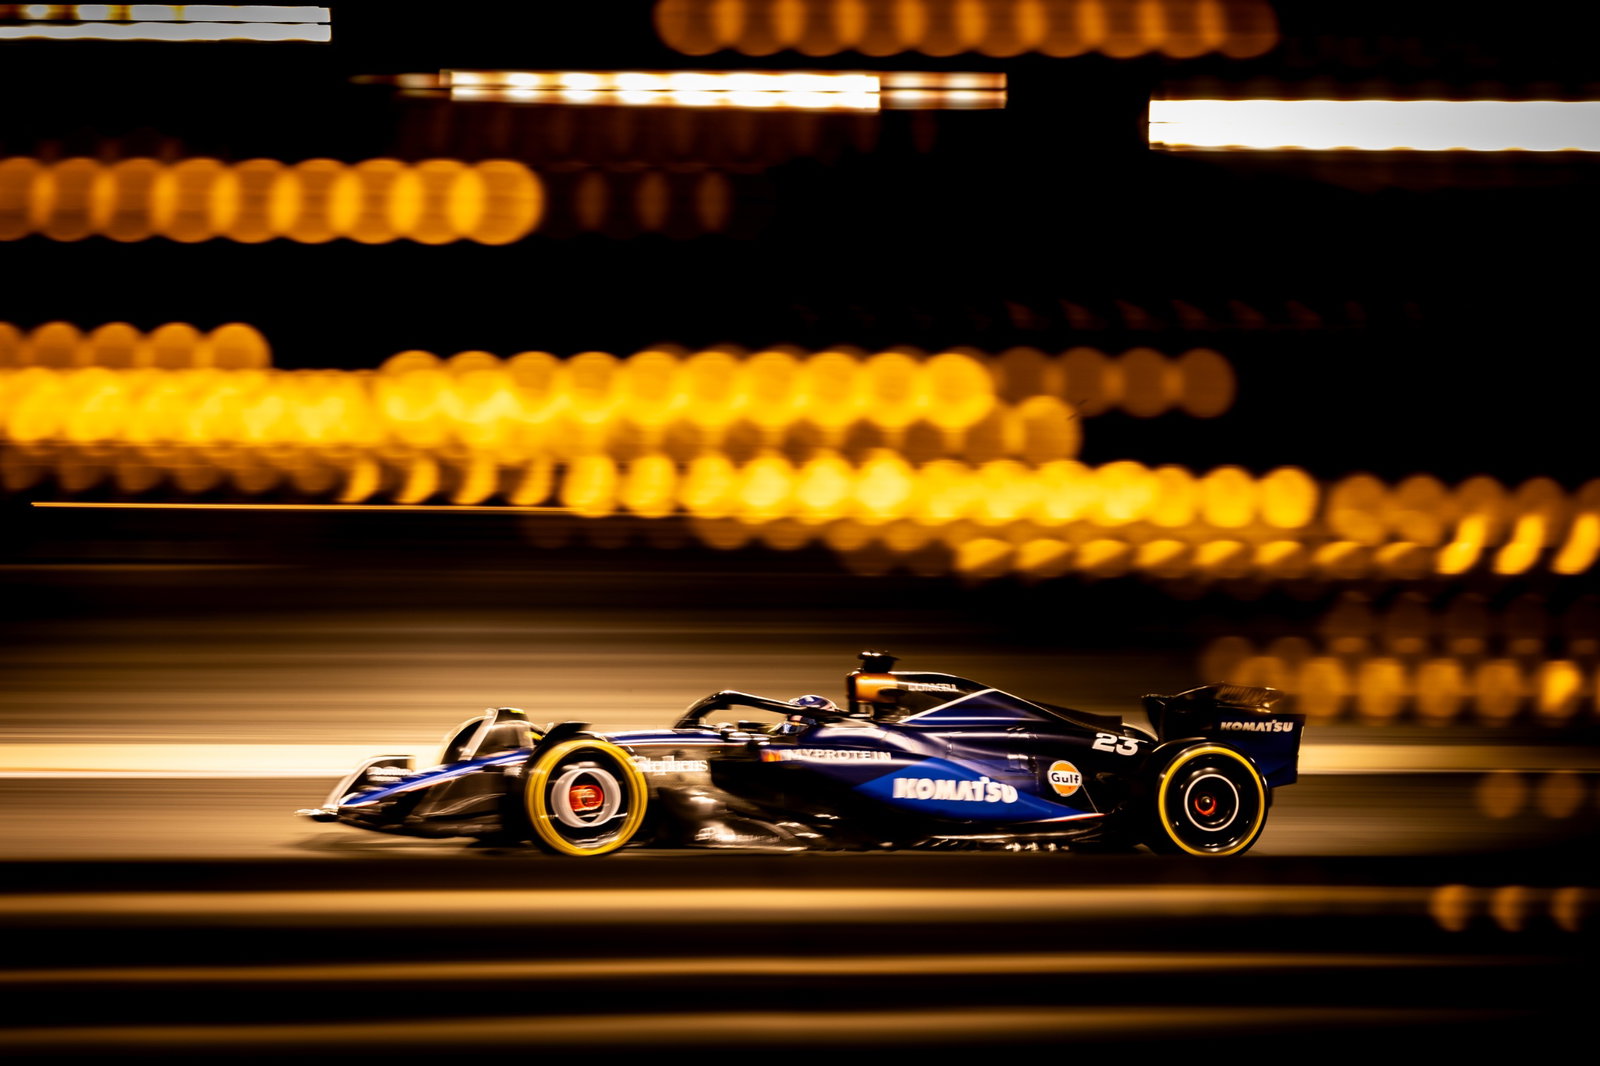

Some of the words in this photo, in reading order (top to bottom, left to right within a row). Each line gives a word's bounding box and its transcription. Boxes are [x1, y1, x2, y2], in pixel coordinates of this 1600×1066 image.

[1220, 719, 1294, 732] KOMATSU
[1092, 732, 1139, 756] 23
[1051, 772, 1081, 784] Gulf
[893, 776, 1018, 804] KOMATSU
